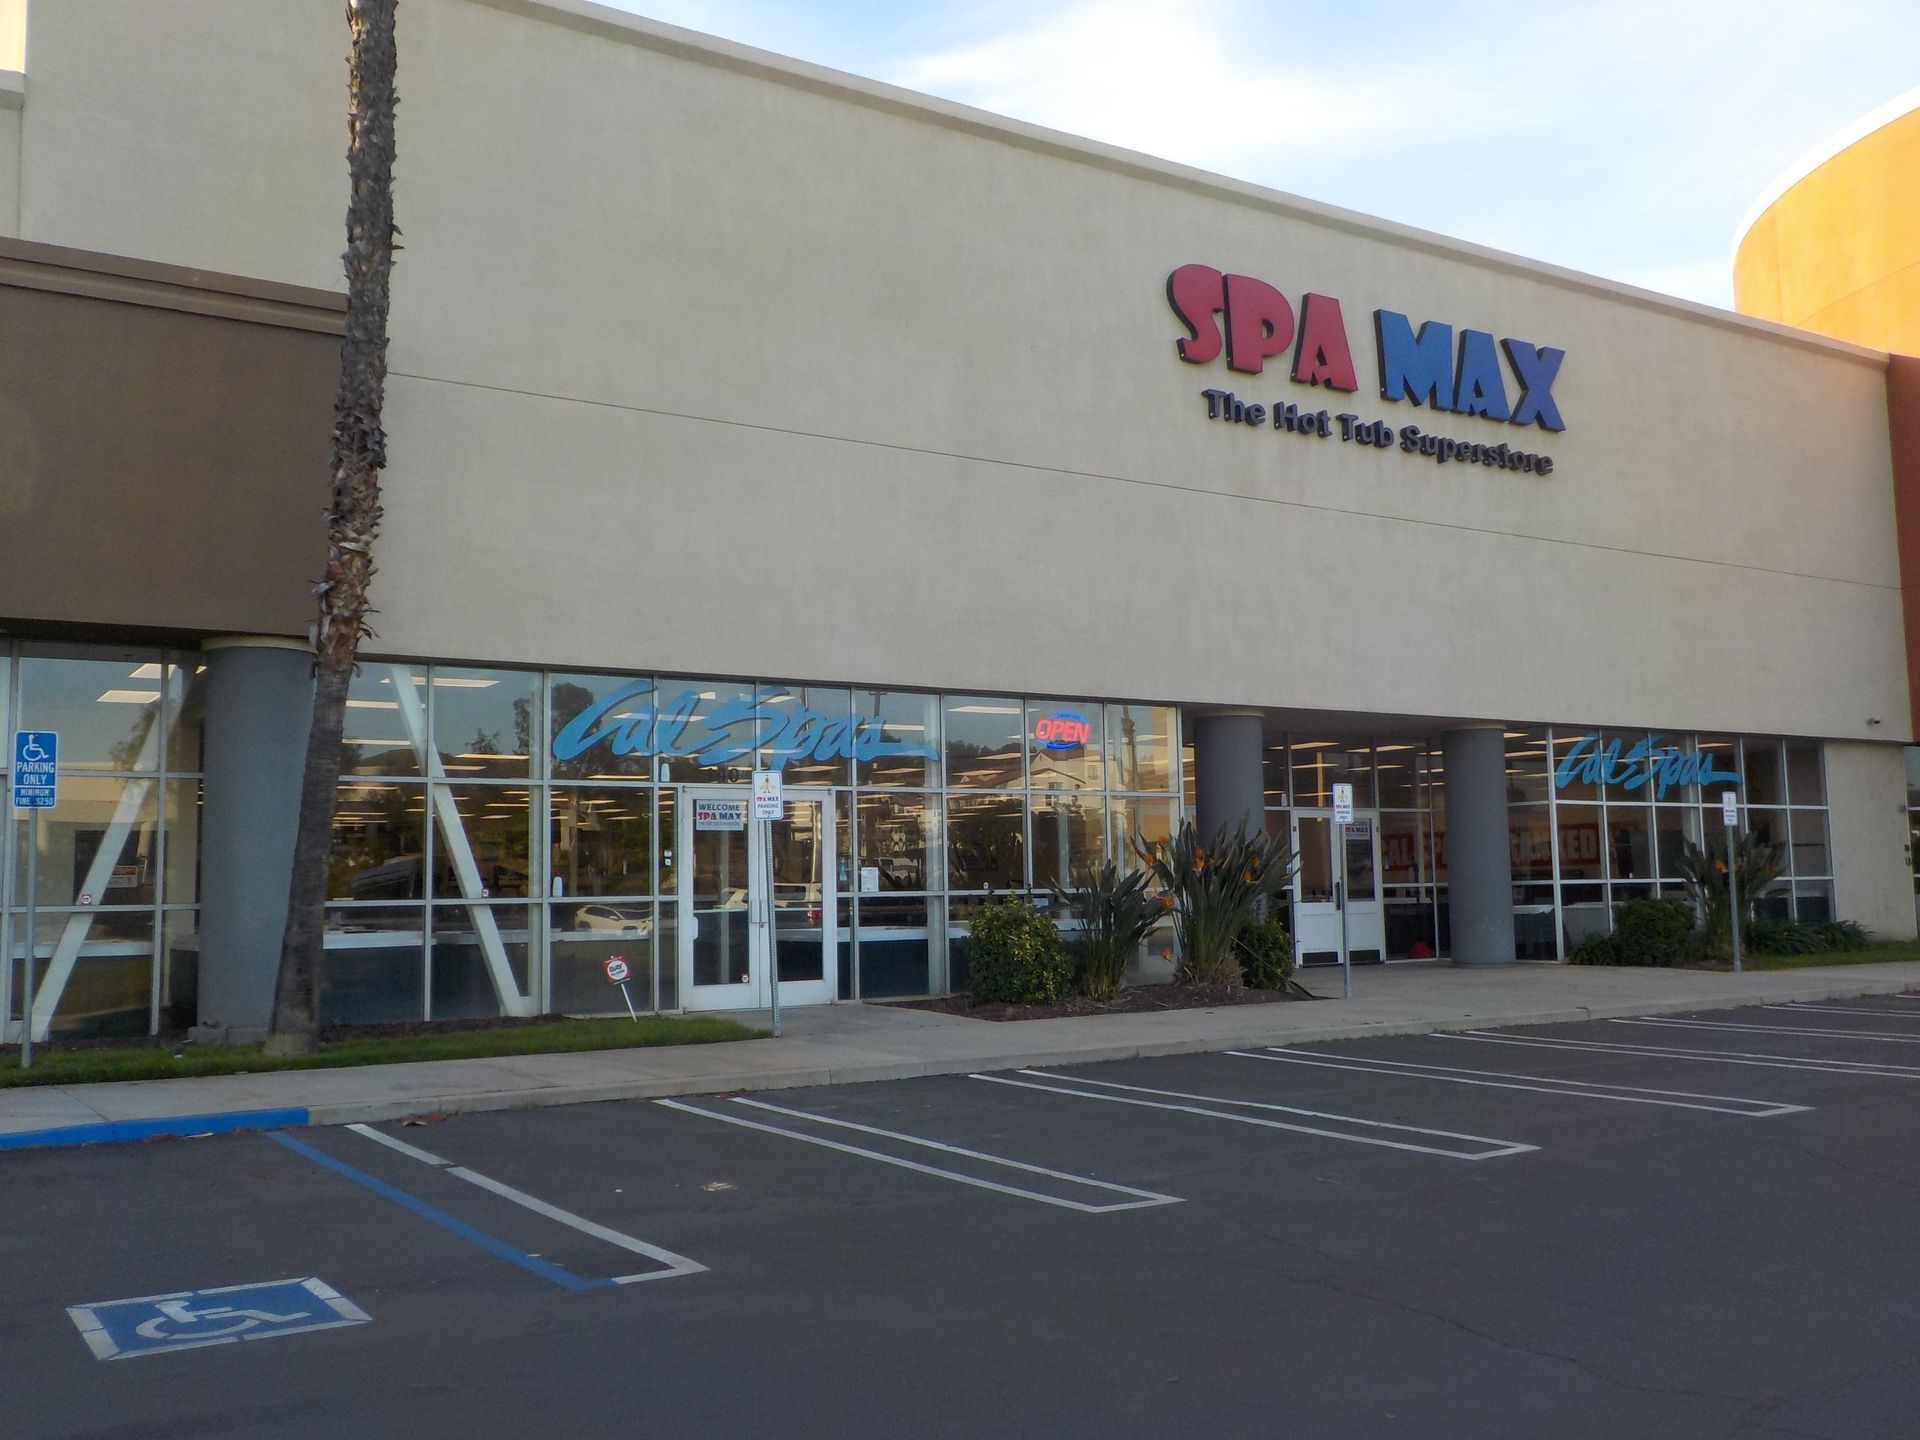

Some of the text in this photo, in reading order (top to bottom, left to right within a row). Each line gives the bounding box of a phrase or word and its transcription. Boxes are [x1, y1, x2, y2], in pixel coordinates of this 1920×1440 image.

[1167, 263, 1566, 432] SPA MAX
[1201, 388, 1554, 475] The Hot Tub Superstore
[553, 679, 940, 771] Cal Spas
[1035, 718, 1090, 743] OPEN
[16, 761, 55, 773] PARKING
[1555, 731, 1742, 800] Cal Spas
[23, 774, 47, 785] ONLY
[20, 788, 50, 796] MINIMUM
[15, 797, 30, 805] FINE
[698, 803, 740, 811] WELCOME
[697, 812, 741, 821] SPA MAX
